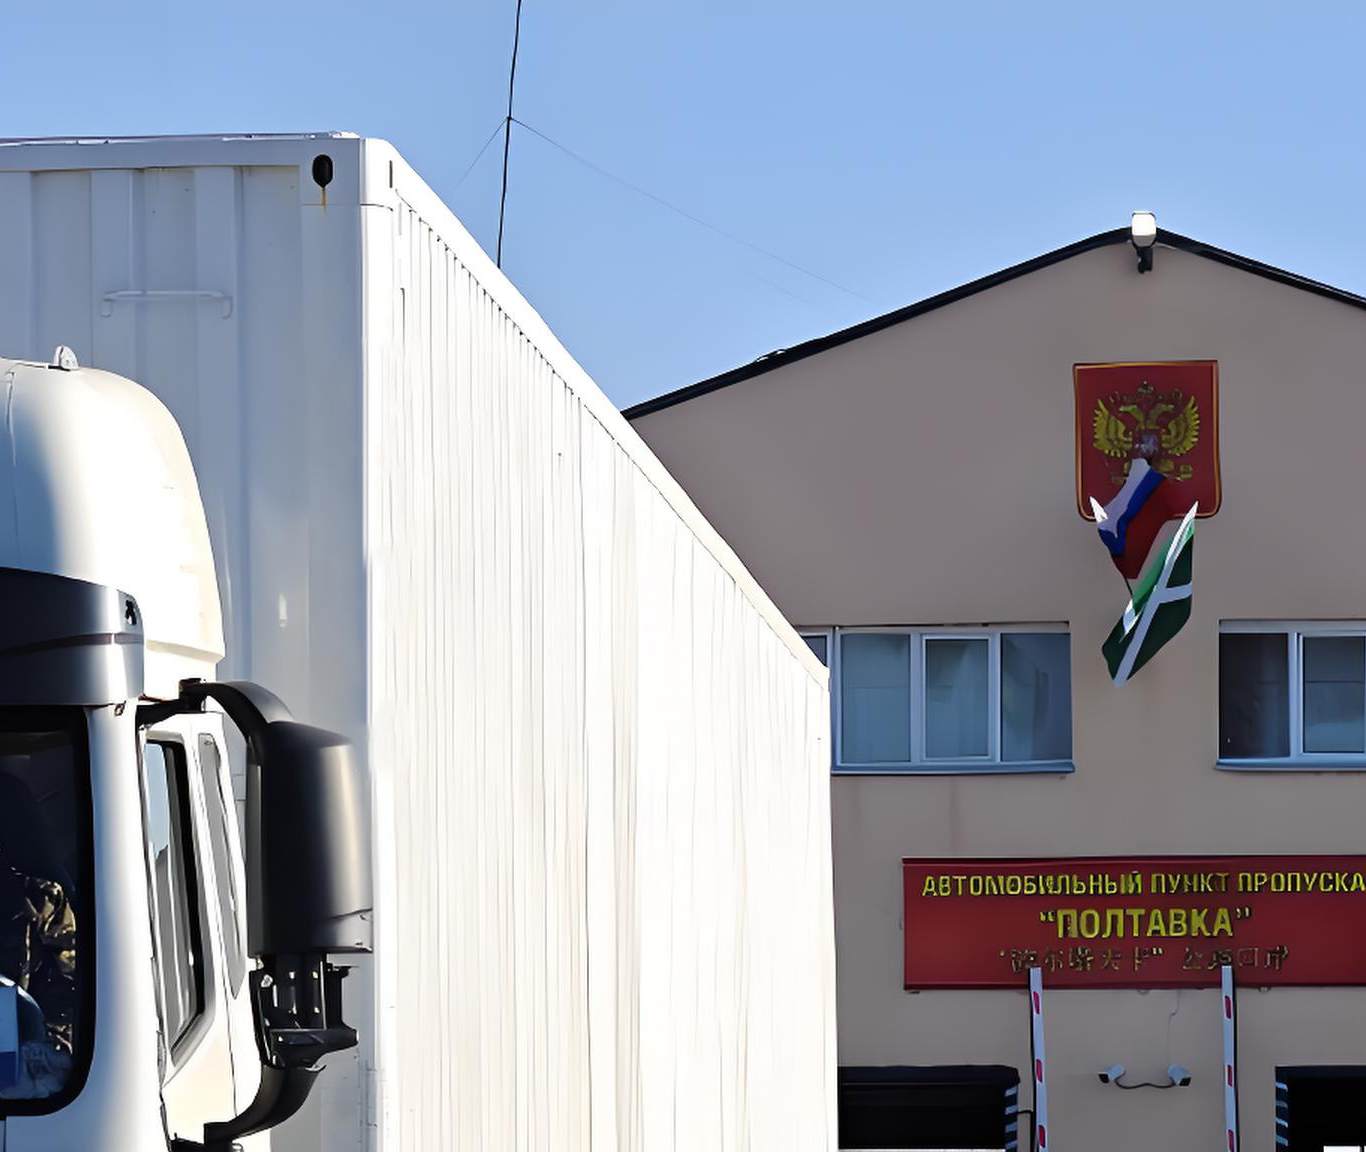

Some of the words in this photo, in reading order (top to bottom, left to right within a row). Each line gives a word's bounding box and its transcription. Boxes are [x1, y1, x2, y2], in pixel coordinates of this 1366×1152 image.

[922, 871, 1143, 897] АВТОМОБИЛЬНЫЙ
[1150, 872, 1230, 894] ПУНКТ
[1238, 871, 1366, 893] ПРОПУСКА
[1040, 907, 1251, 939] "ПОЛТАВКА"
